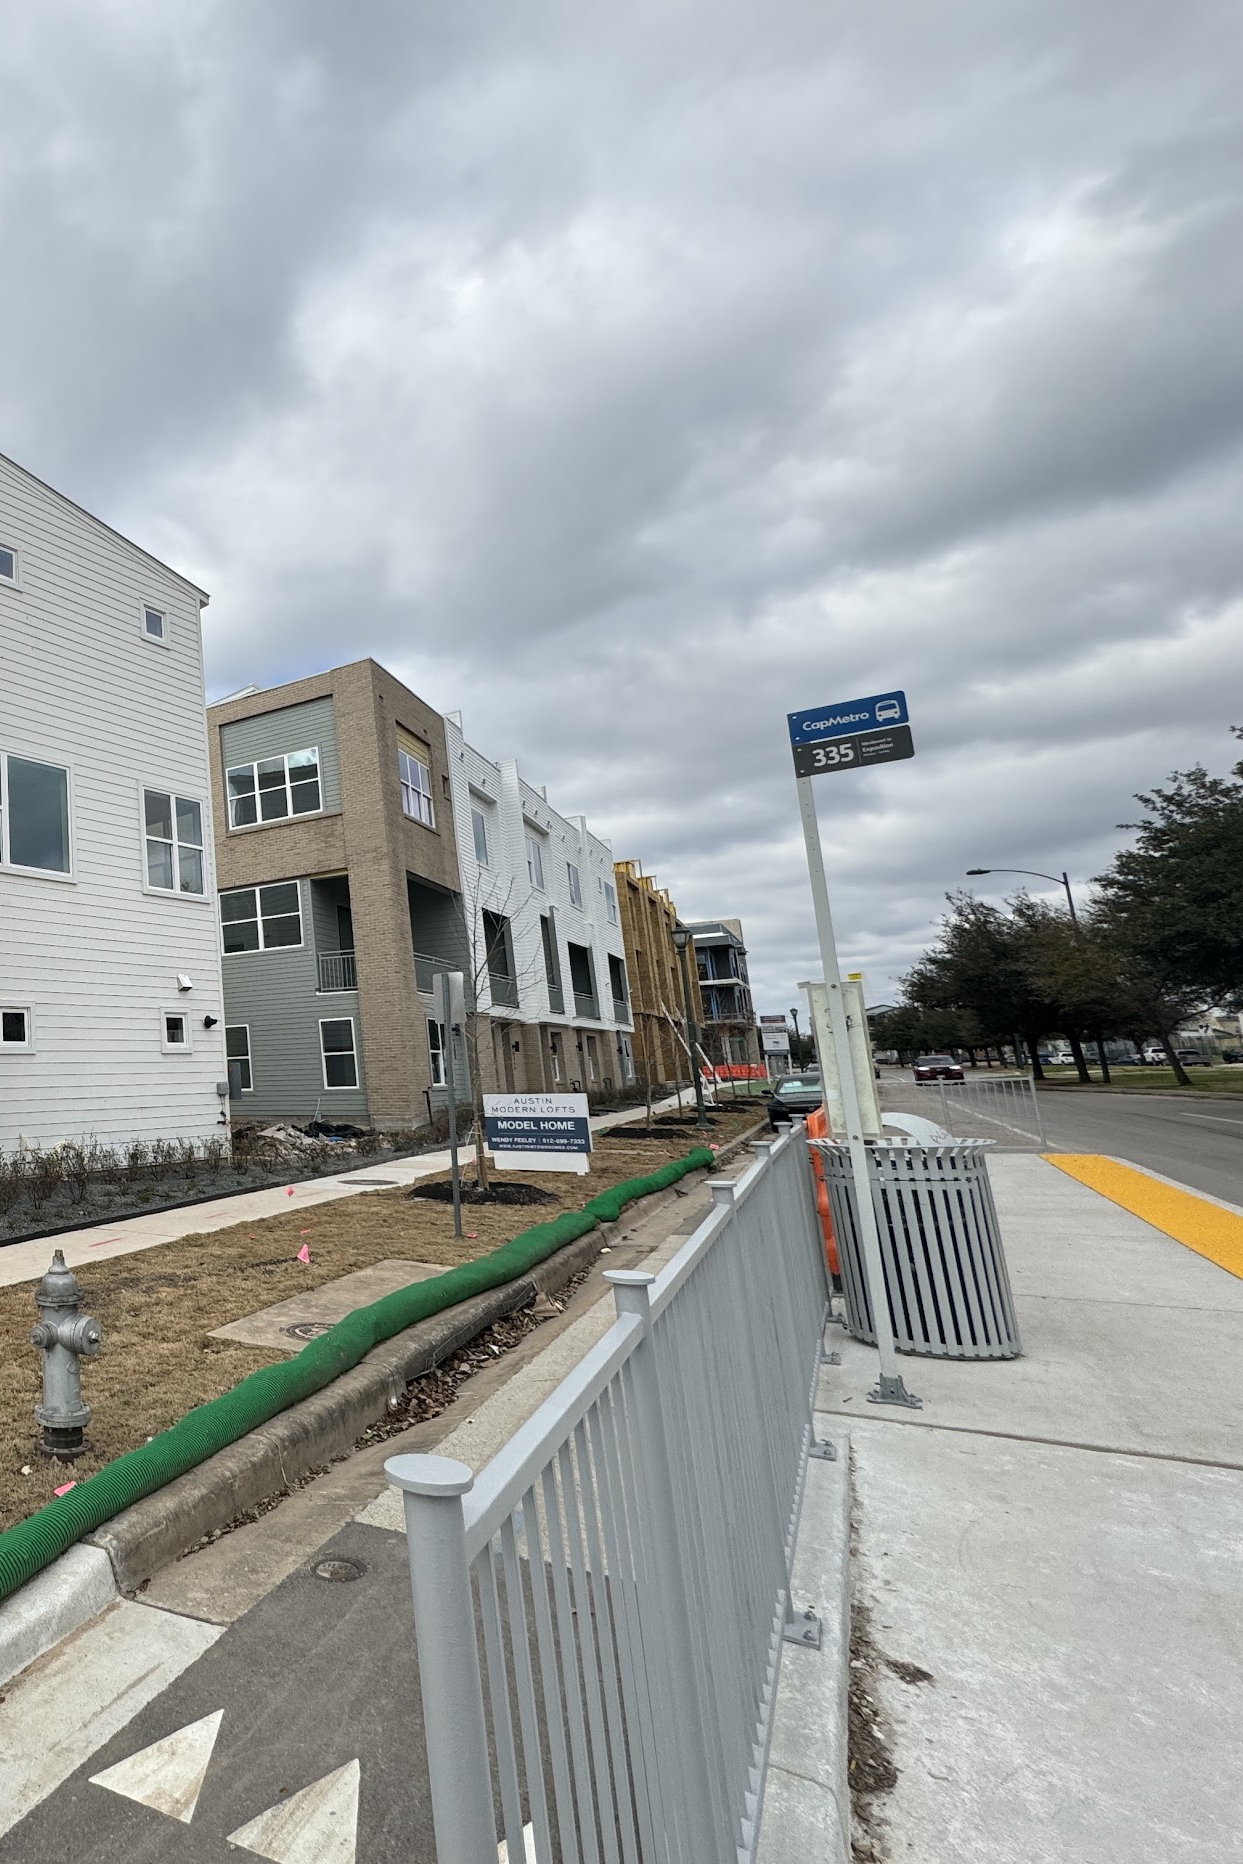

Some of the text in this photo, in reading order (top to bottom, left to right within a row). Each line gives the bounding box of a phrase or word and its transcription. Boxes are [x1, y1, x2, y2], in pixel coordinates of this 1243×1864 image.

[802, 712, 869, 731] CapMetro
[811, 743, 854, 767] 335
[513, 1097, 553, 1105] AUSTIN
[497, 1121, 576, 1130] MODEL HOME
